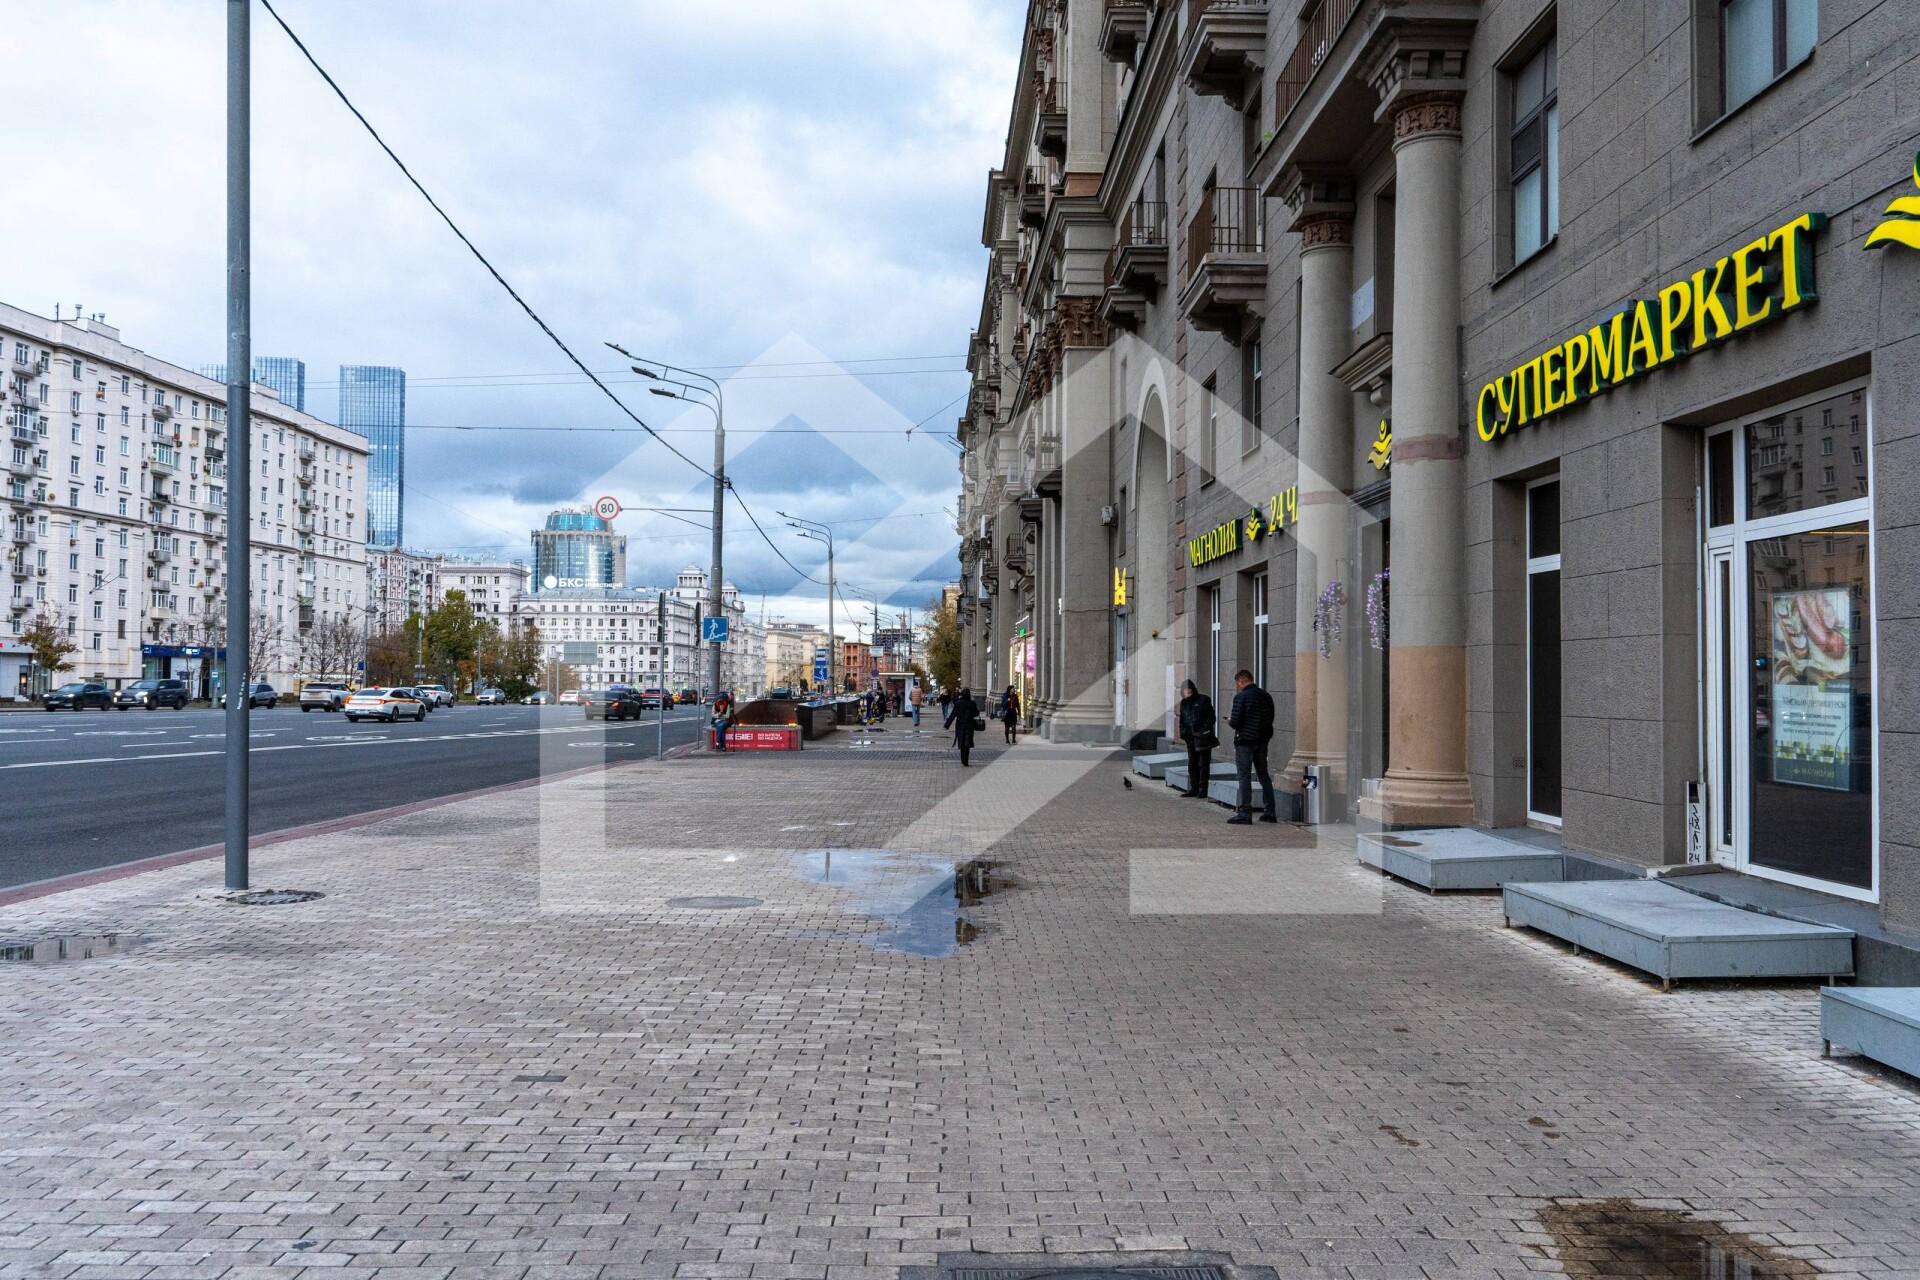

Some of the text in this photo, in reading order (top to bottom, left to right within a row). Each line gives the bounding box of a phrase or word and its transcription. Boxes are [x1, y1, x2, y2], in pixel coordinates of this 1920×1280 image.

[1476, 212, 1812, 443] СУПЕРМАРКЕТ
[600, 503, 615, 514] 80
[1189, 519, 1237, 567] МАГНОЛИЯ
[1269, 491, 1283, 532] 24
[558, 577, 584, 588] БКС
